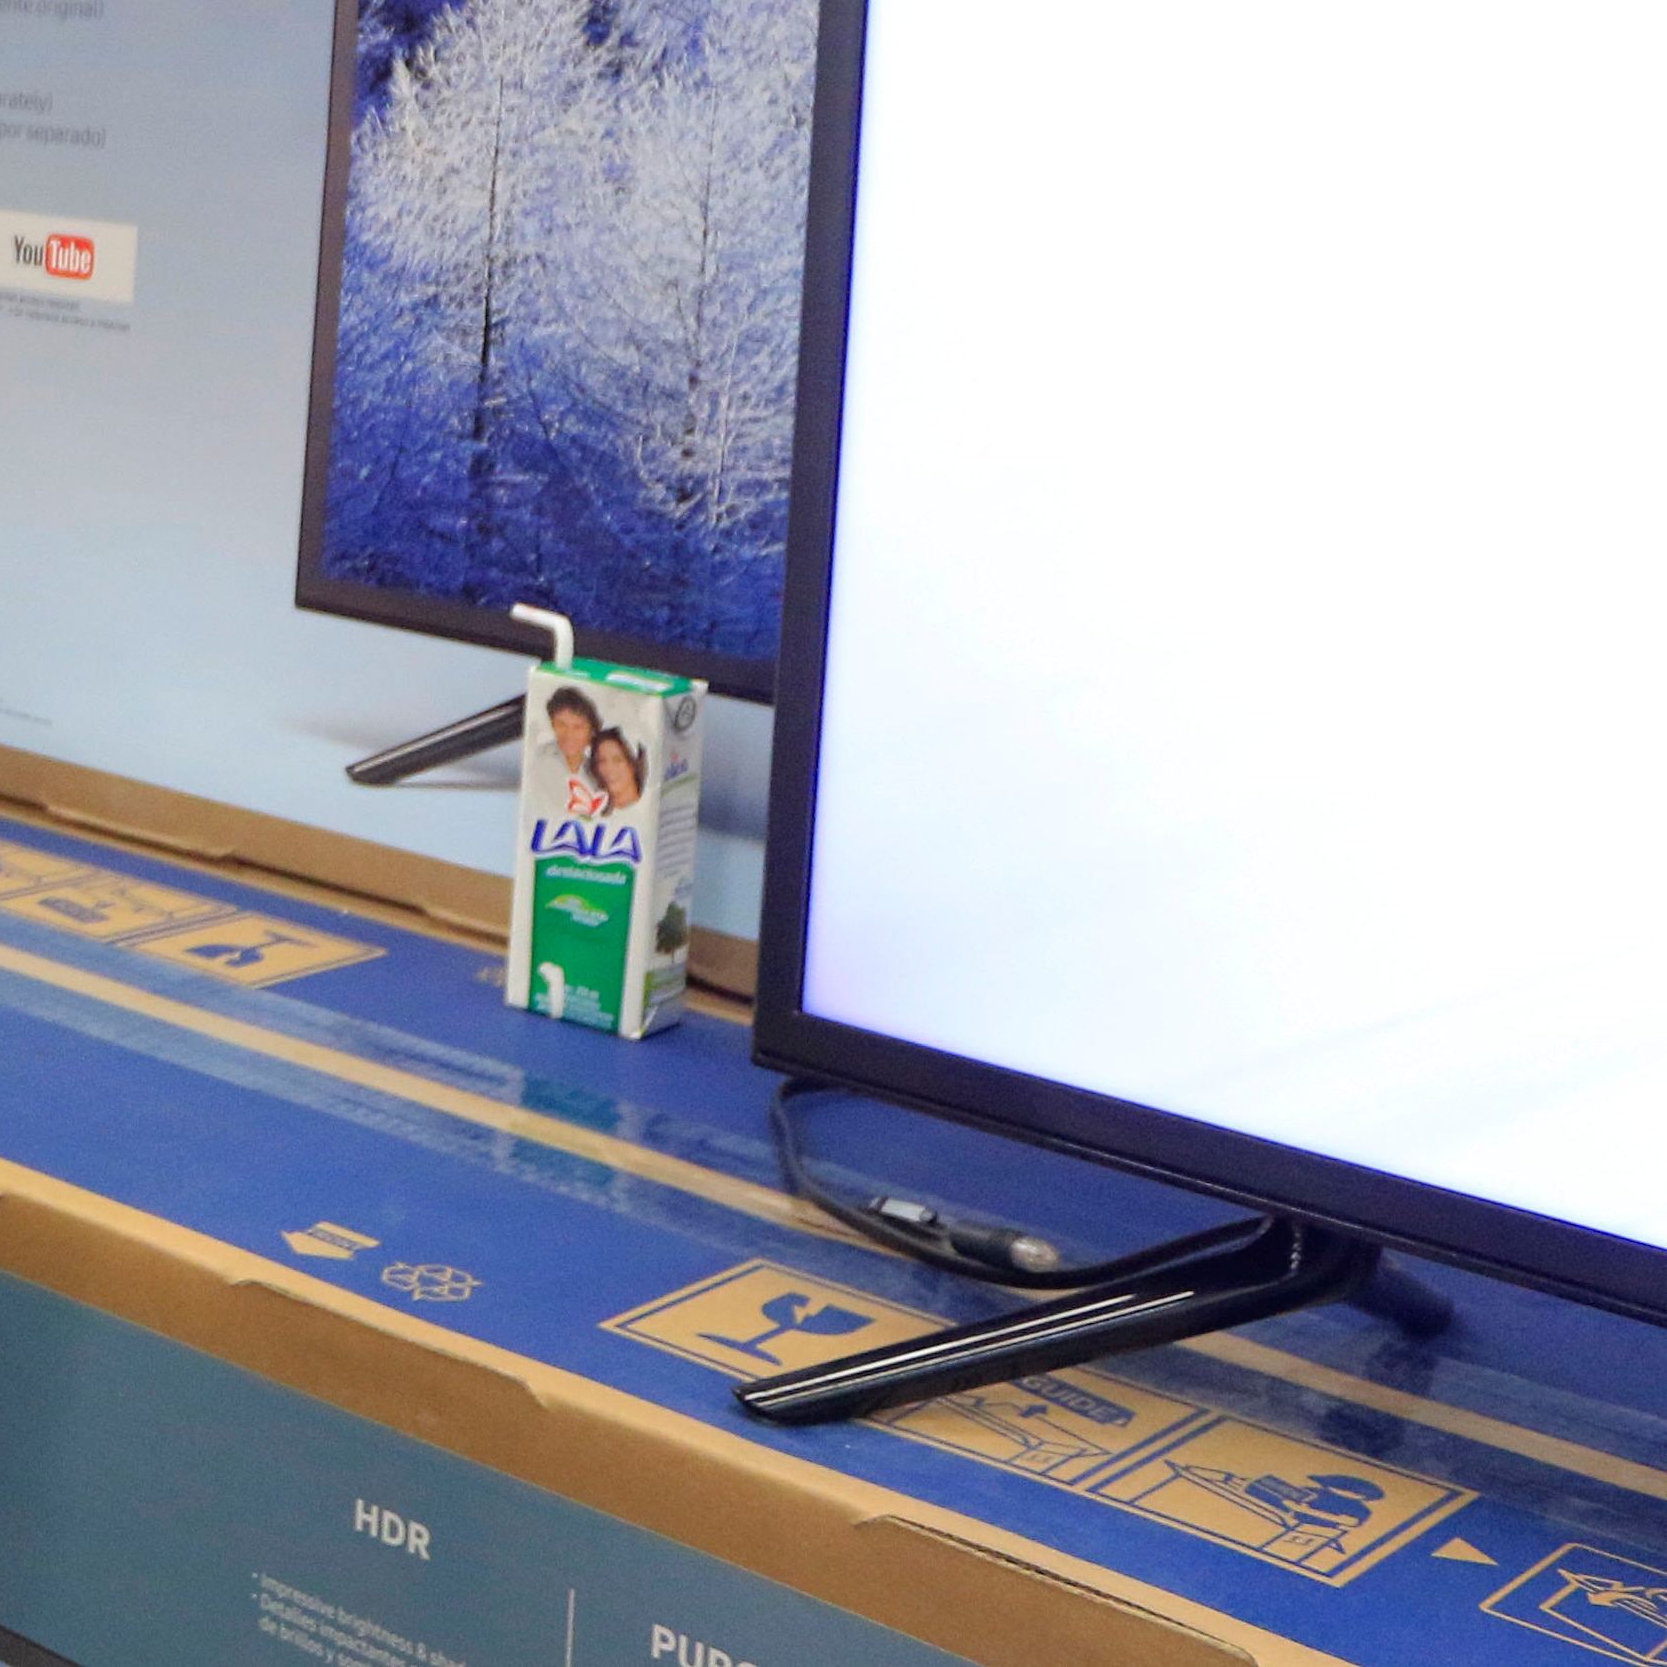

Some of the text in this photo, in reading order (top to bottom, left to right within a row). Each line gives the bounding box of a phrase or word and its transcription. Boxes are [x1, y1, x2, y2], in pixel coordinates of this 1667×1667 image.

[13, 234, 95, 279] YouTube
[530, 817, 643, 864] LALA
[1021, 1372, 1115, 1422] GUIDE
[354, 1498, 432, 1561] HDR
